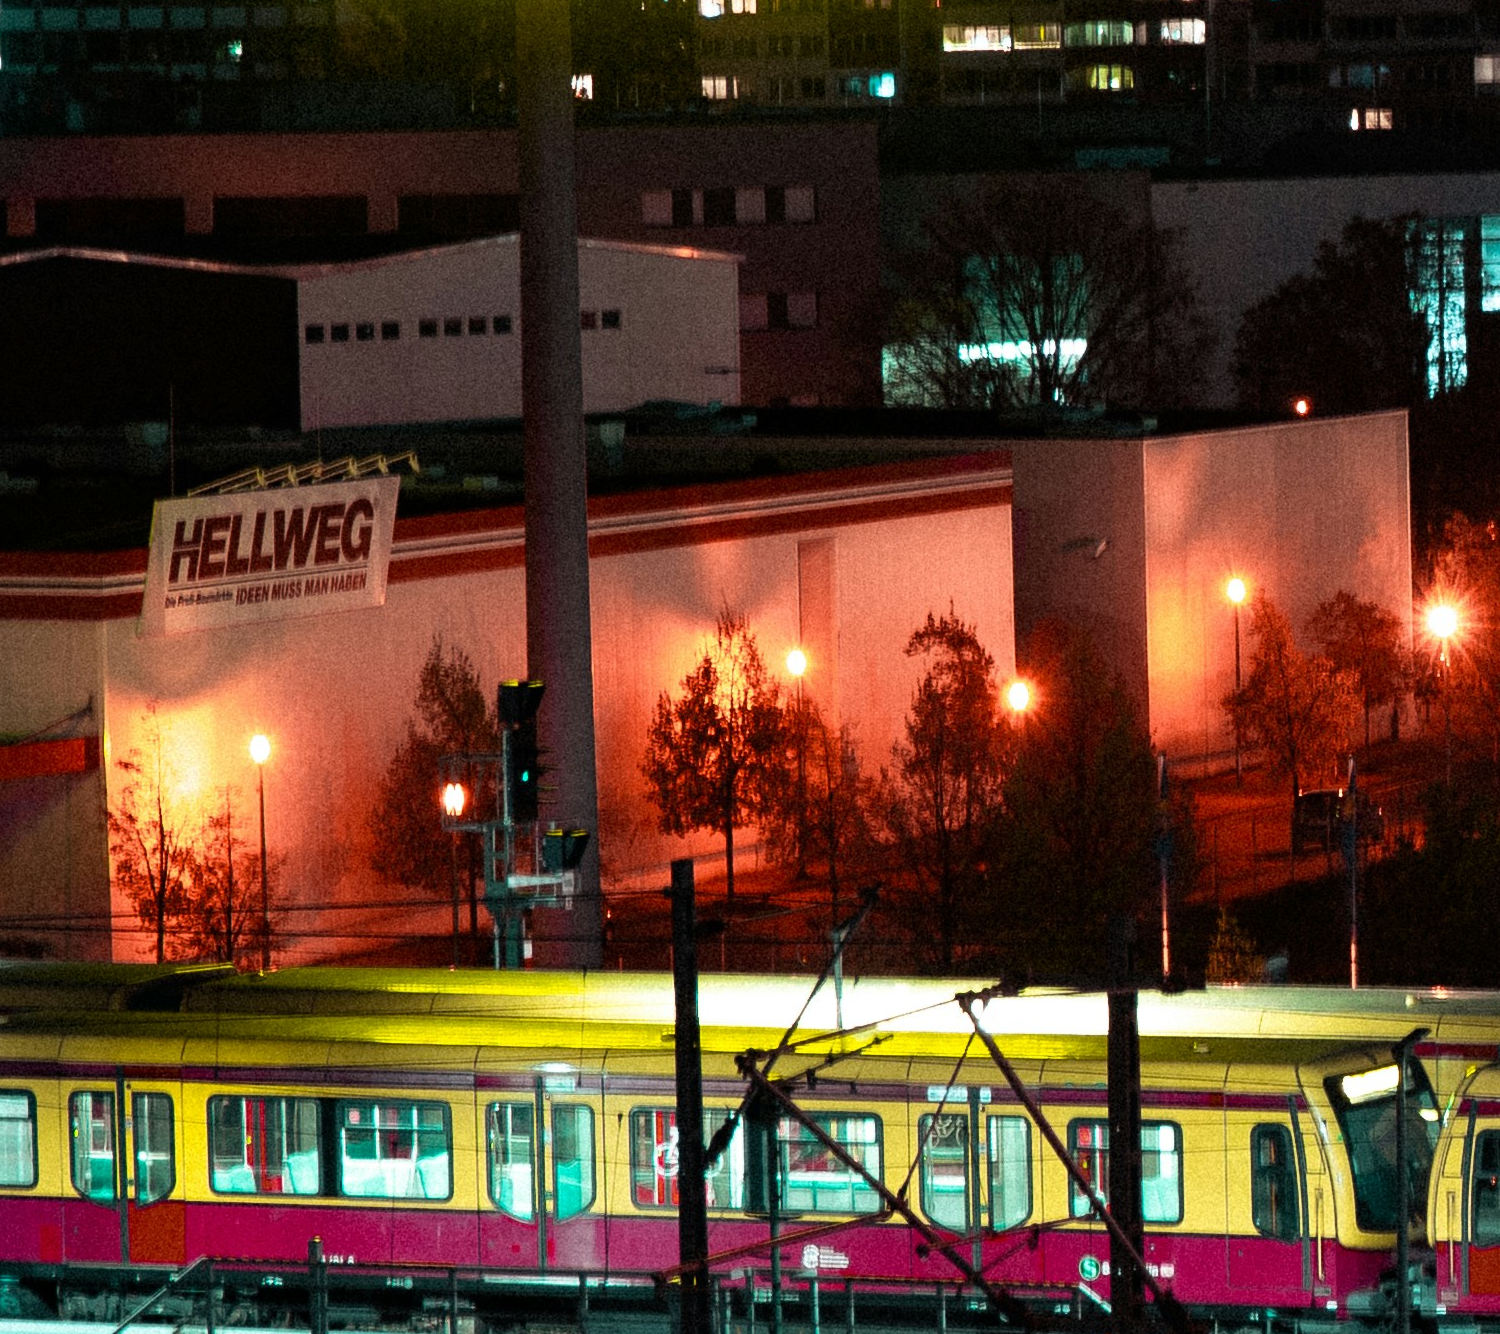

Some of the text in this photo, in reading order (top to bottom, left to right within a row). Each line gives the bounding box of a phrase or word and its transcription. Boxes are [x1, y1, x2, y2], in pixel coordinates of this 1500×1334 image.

[168, 498, 374, 584] HELLWEG
[236, 583, 270, 606] IDEEN
[271, 579, 302, 601] MUSS
[304, 576, 329, 597] MAN
[331, 571, 367, 593] HABEN
